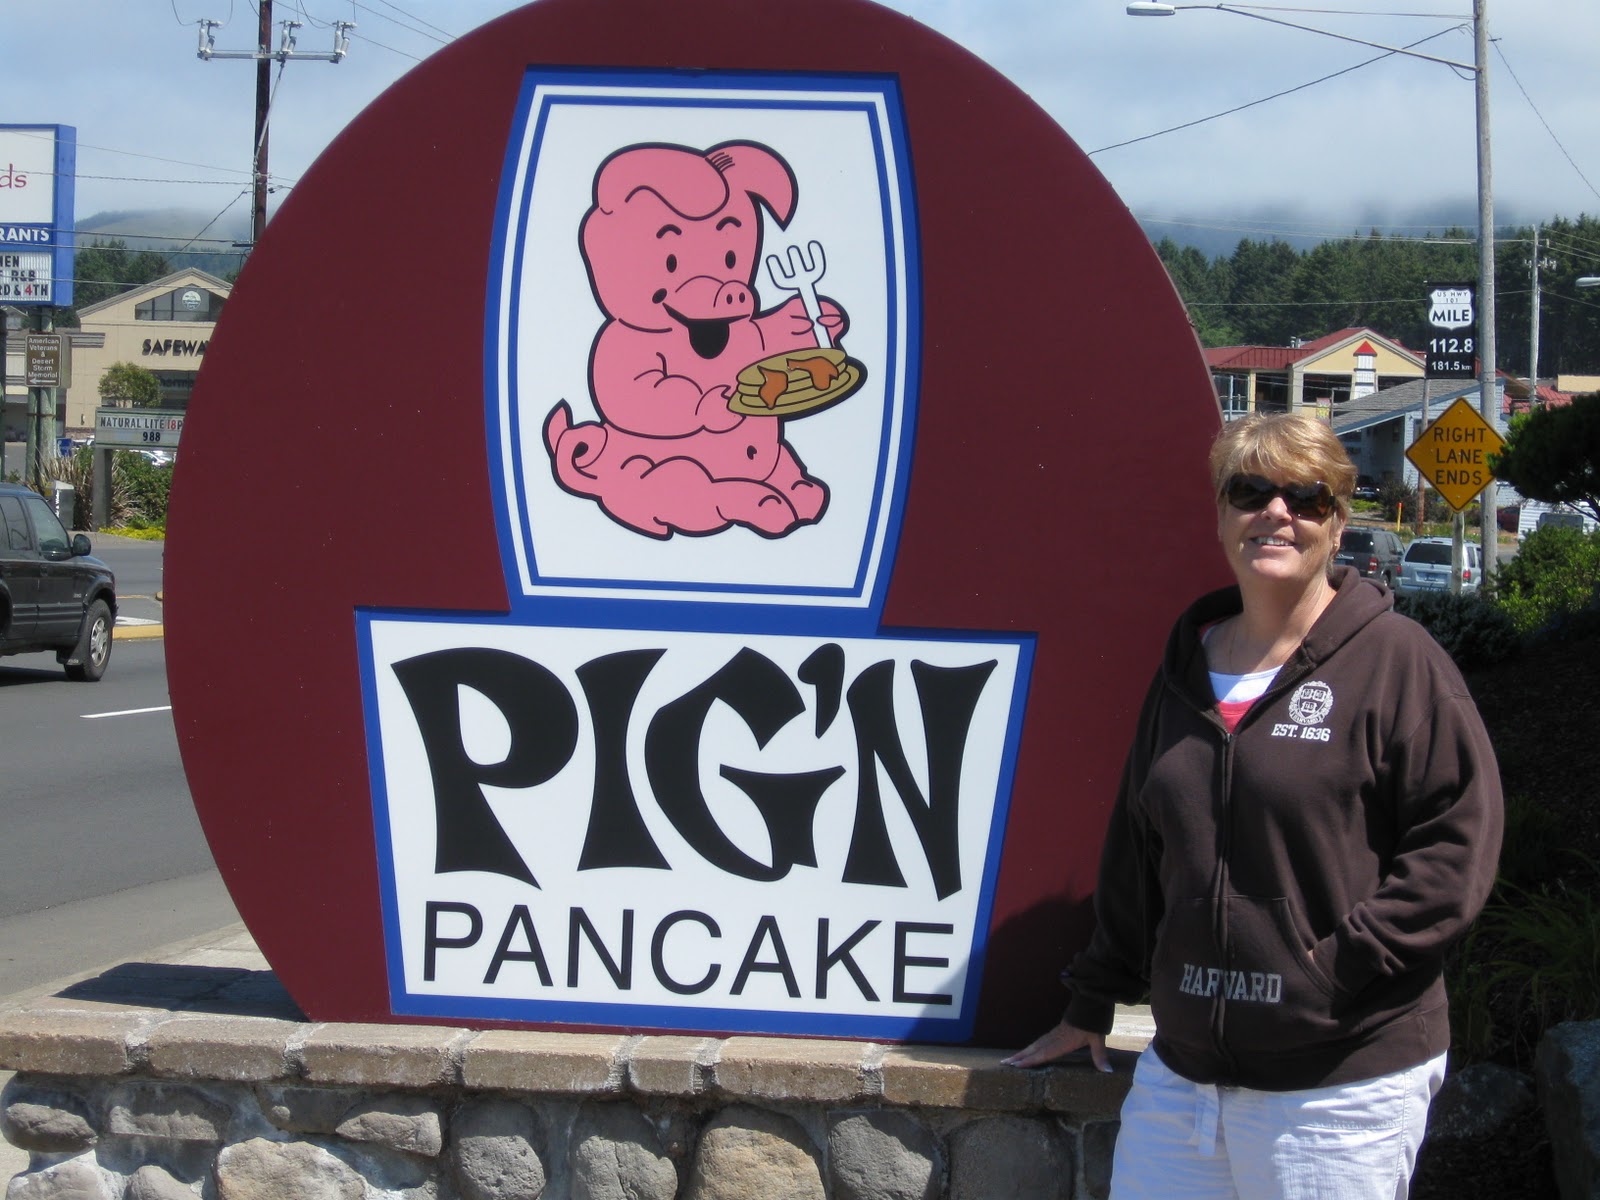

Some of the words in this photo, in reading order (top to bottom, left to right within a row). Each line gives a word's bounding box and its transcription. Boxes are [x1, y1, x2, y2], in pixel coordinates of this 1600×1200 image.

[11, 270, 36, 282] R&B
[14, 284, 21, 296] &
[24, 284, 49, 296] 4TH
[1432, 309, 1470, 322] MILE
[1429, 338, 1474, 354] 112.8
[1431, 361, 1460, 371] 181.5
[1461, 363, 1472, 371] km
[100, 416, 142, 429] NATURAL
[144, 418, 165, 430] LITE
[142, 431, 161, 442] 988
[1433, 426, 1487, 443] RIGHT
[1436, 447, 1482, 465] LANE
[1435, 469, 1482, 486] ENDS
[1271, 723, 1299, 738] EST.
[1300, 726, 1331, 742] 1636
[390, 642, 999, 902] PIG'N
[422, 900, 954, 1006] PANCAKE
[1179, 963, 1282, 1003] HARVARD
